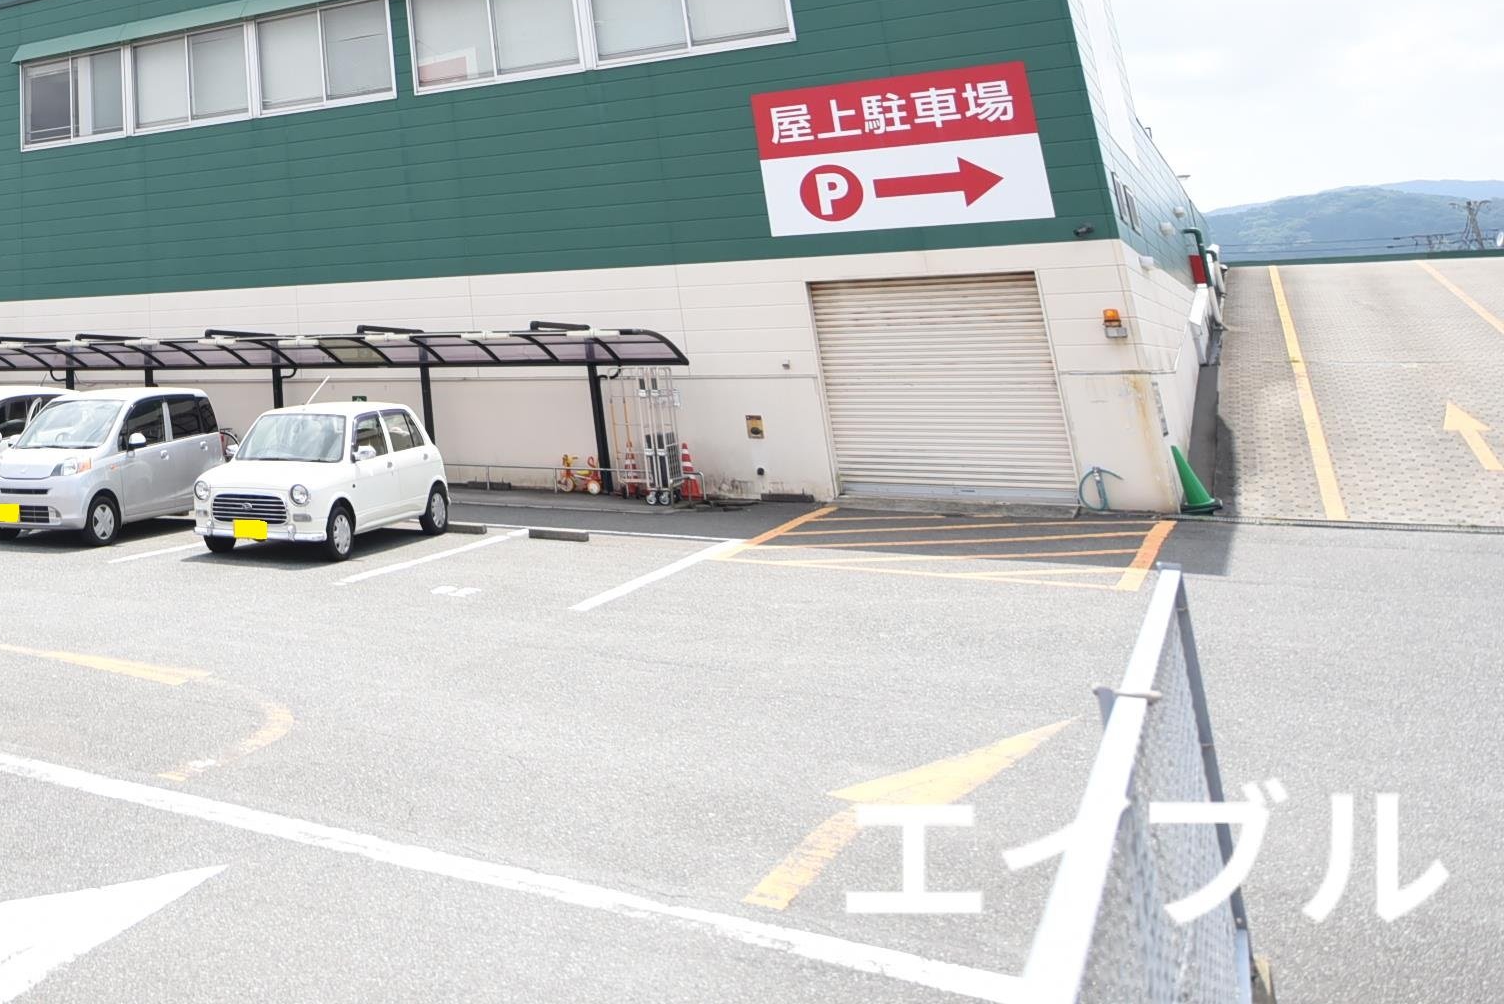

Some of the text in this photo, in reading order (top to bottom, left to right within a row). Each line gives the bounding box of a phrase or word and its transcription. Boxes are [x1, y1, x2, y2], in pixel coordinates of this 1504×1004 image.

[771, 80, 1015, 145] 屋上駐車場
[814, 173, 849, 216] P
